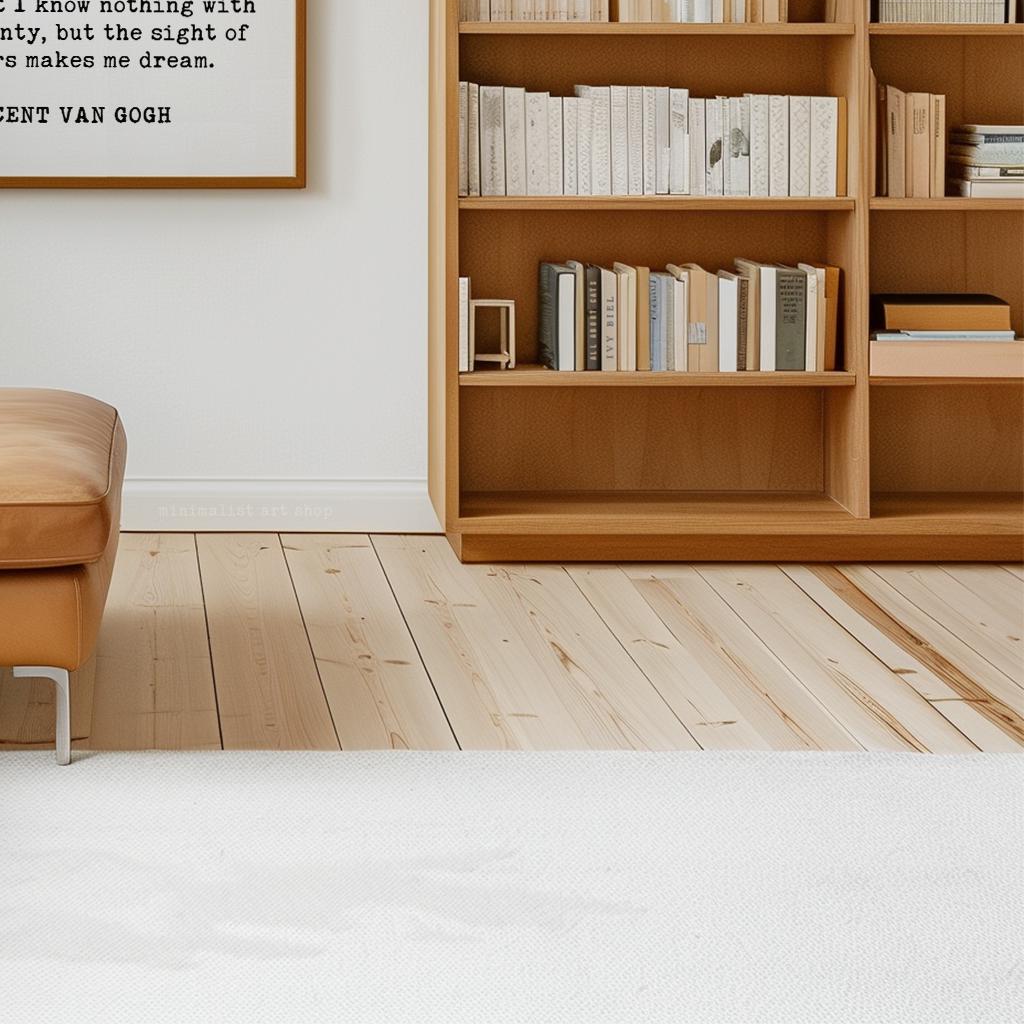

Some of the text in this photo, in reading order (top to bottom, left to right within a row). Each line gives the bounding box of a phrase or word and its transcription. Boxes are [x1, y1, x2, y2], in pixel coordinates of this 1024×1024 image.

[55, 23, 95, 41] but
[103, 23, 143, 41] the
[151, 23, 217, 45] sight
[225, 23, 251, 42] of
[25, 50, 95, 69] makes
[103, 55, 131, 69] me
[139, 50, 216, 69] dream.
[58, 106, 106, 124] VAN
[114, 106, 172, 124] GOGH
[589, 281, 597, 361] ALL ABOUT CATS
[606, 296, 615, 359] IVY BIEL
